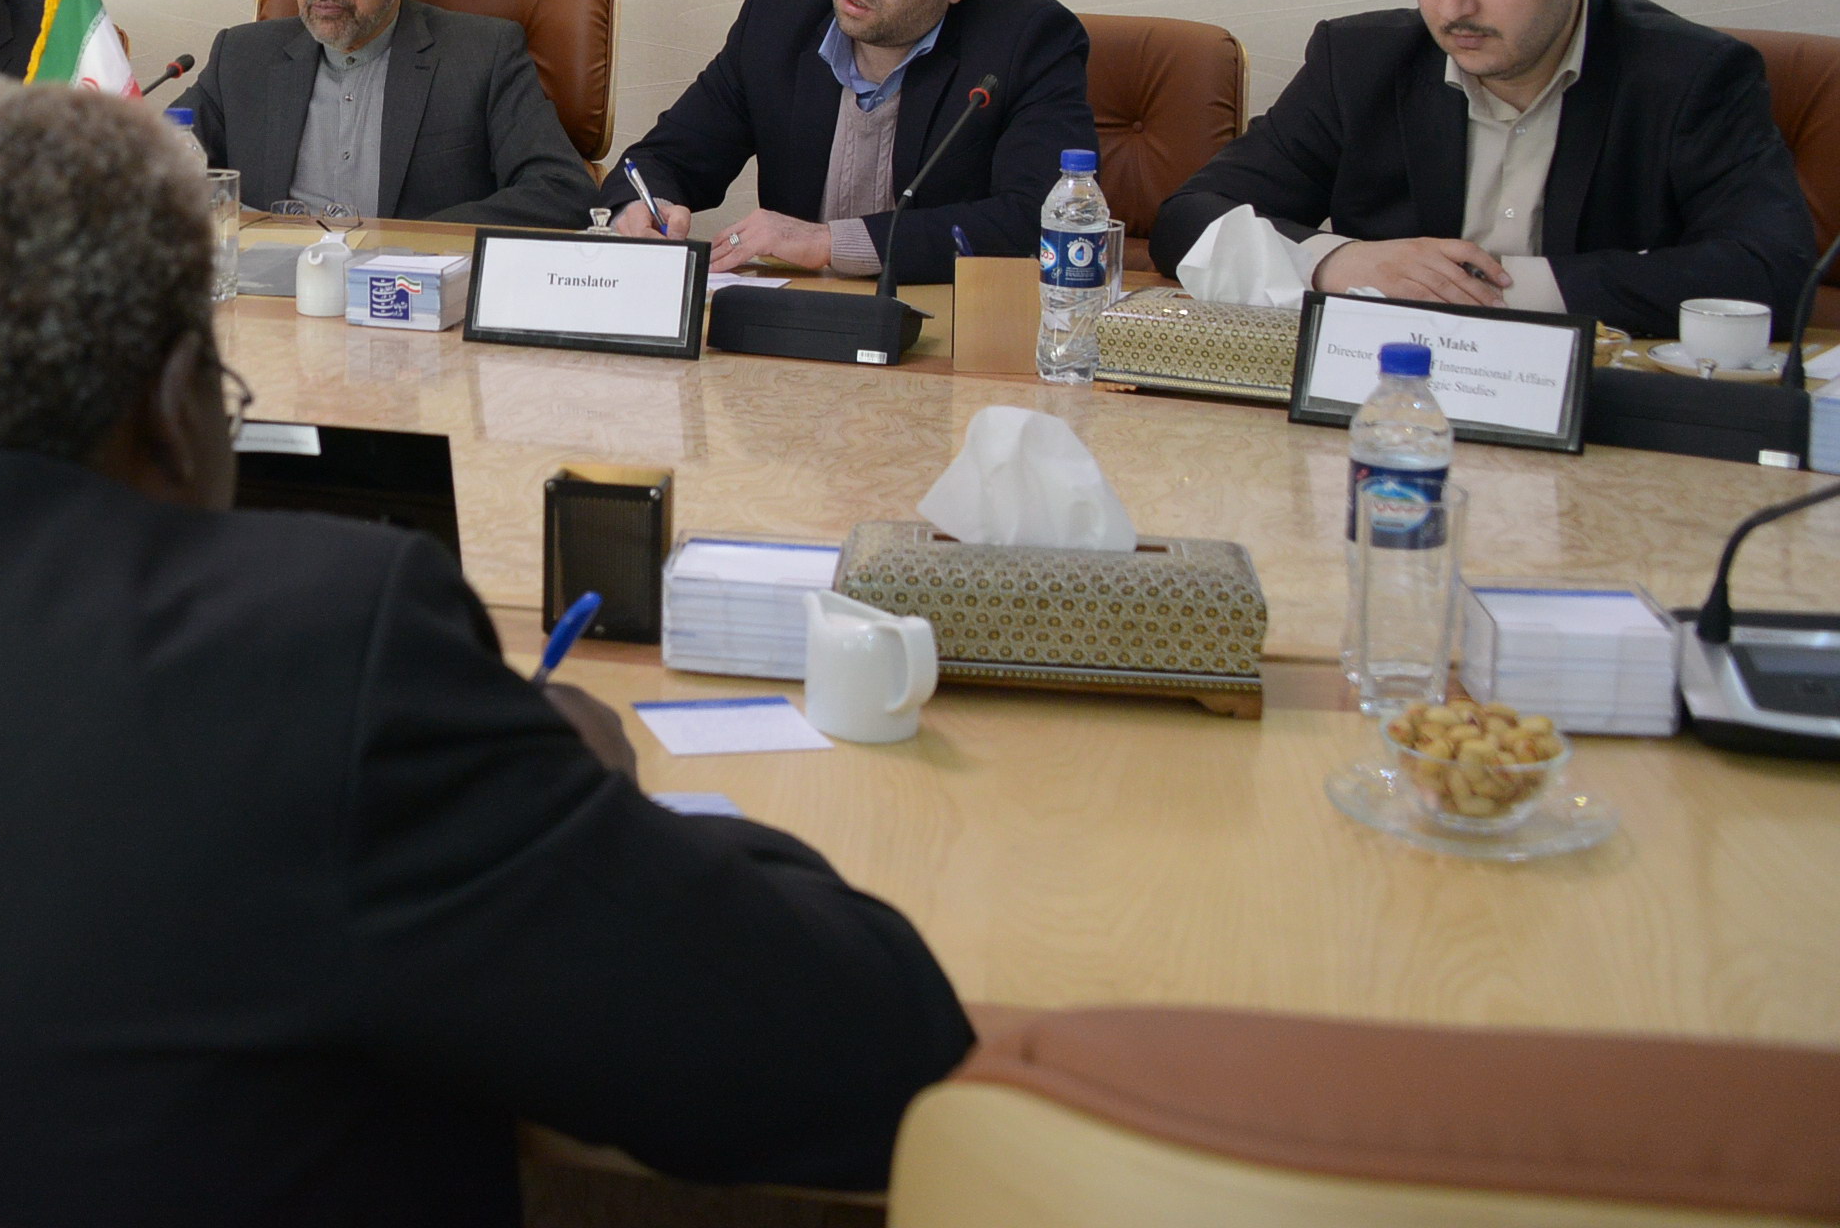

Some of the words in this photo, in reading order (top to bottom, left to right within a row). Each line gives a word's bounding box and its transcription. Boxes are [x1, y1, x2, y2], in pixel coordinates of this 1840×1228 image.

[547, 272, 619, 288] Translator
[1439, 336, 1479, 353] Malek
[1327, 343, 1373, 360] Director
[1439, 361, 1512, 381] International
[1515, 372, 1557, 387] Affairs
[1455, 381, 1496, 397] Studies
